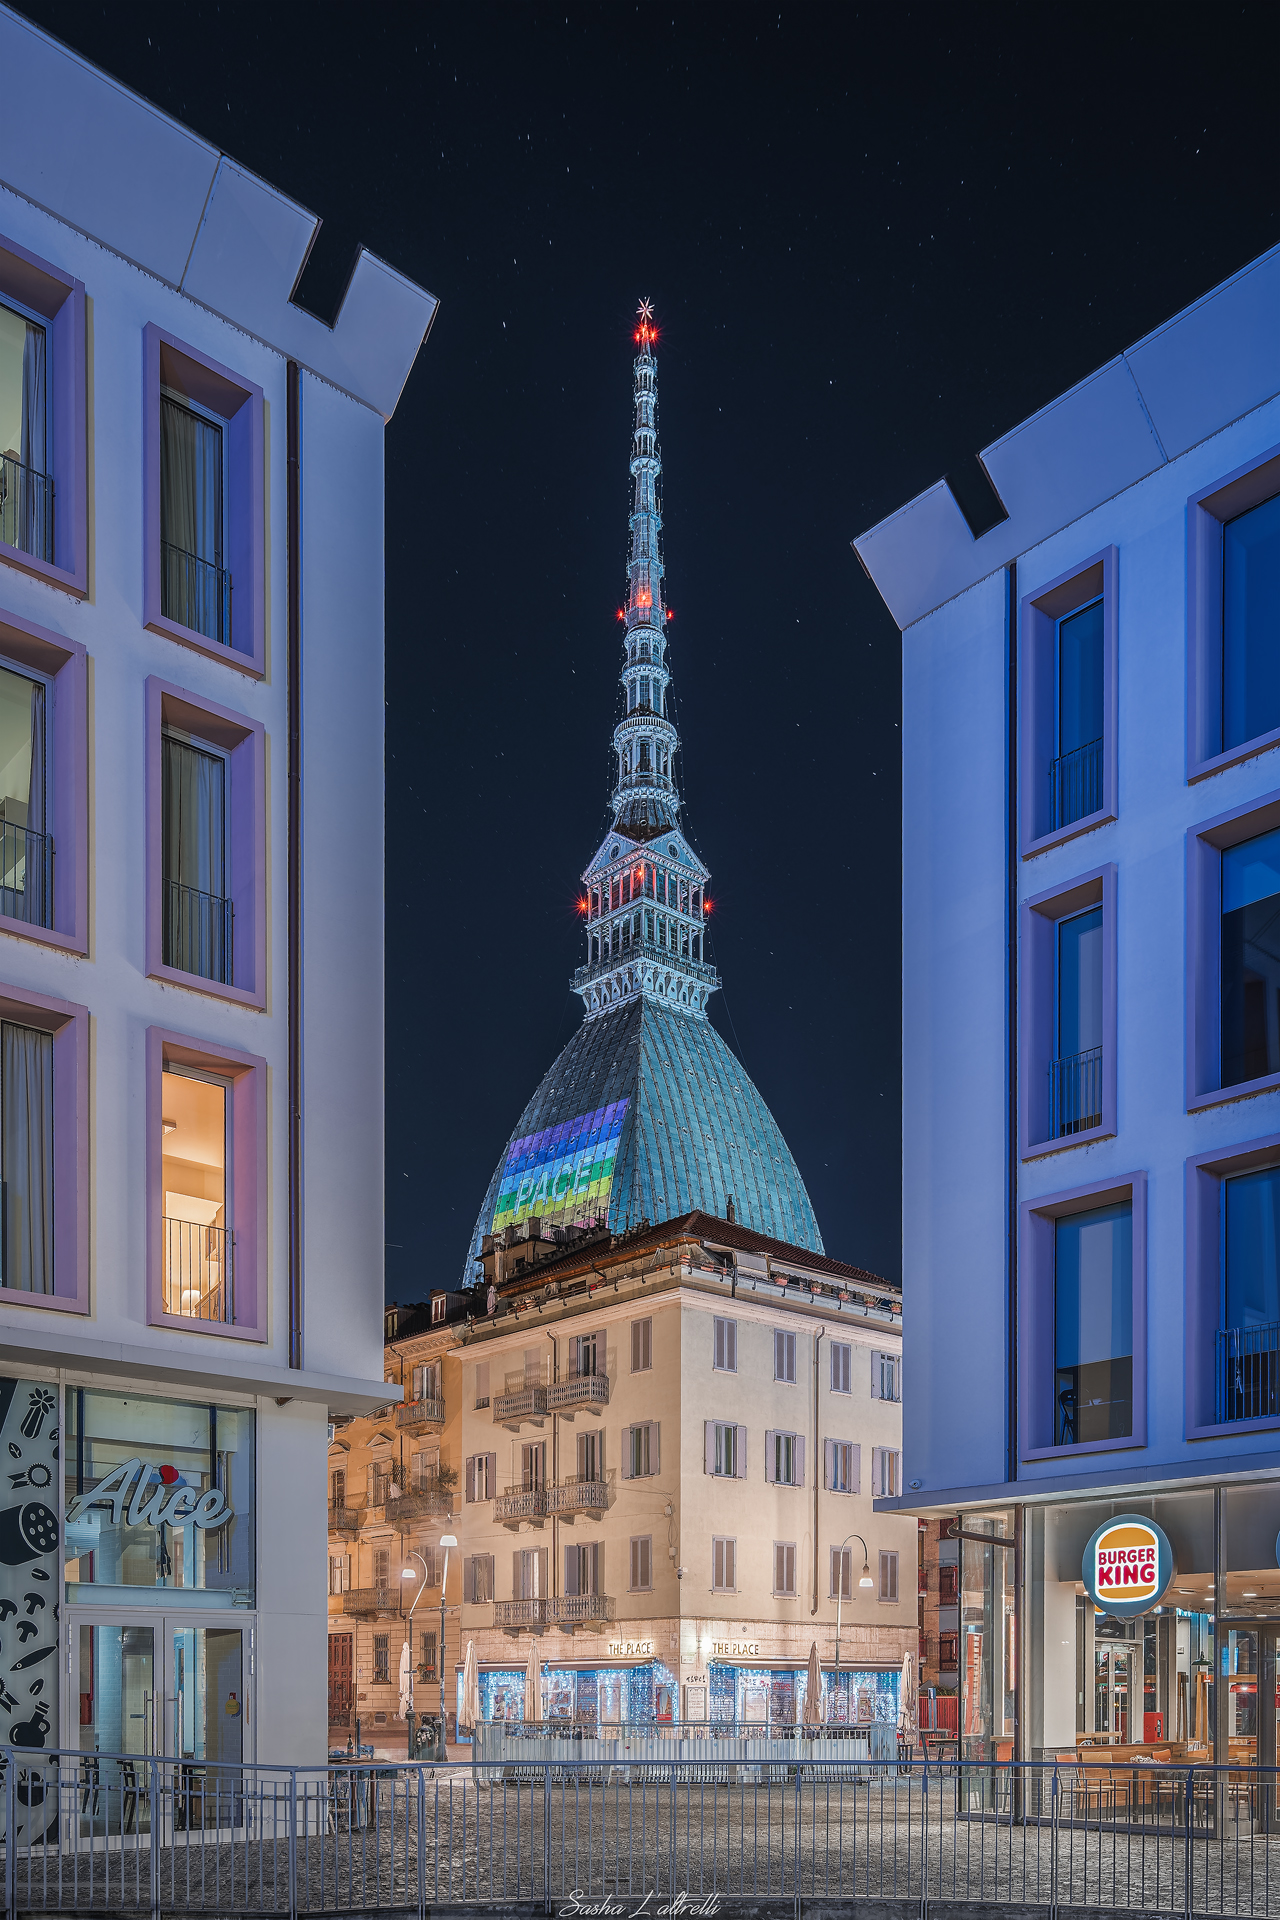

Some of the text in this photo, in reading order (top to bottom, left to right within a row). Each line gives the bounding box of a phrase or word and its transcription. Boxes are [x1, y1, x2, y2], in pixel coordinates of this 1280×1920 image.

[513, 1154, 594, 1217] PACE
[65, 1457, 234, 1529] Alice
[1098, 1547, 1156, 1566] BURGER
[1098, 1563, 1156, 1587] KING
[609, 1642, 652, 1655] THE PLACE
[712, 1642, 759, 1655] THE PLACE
